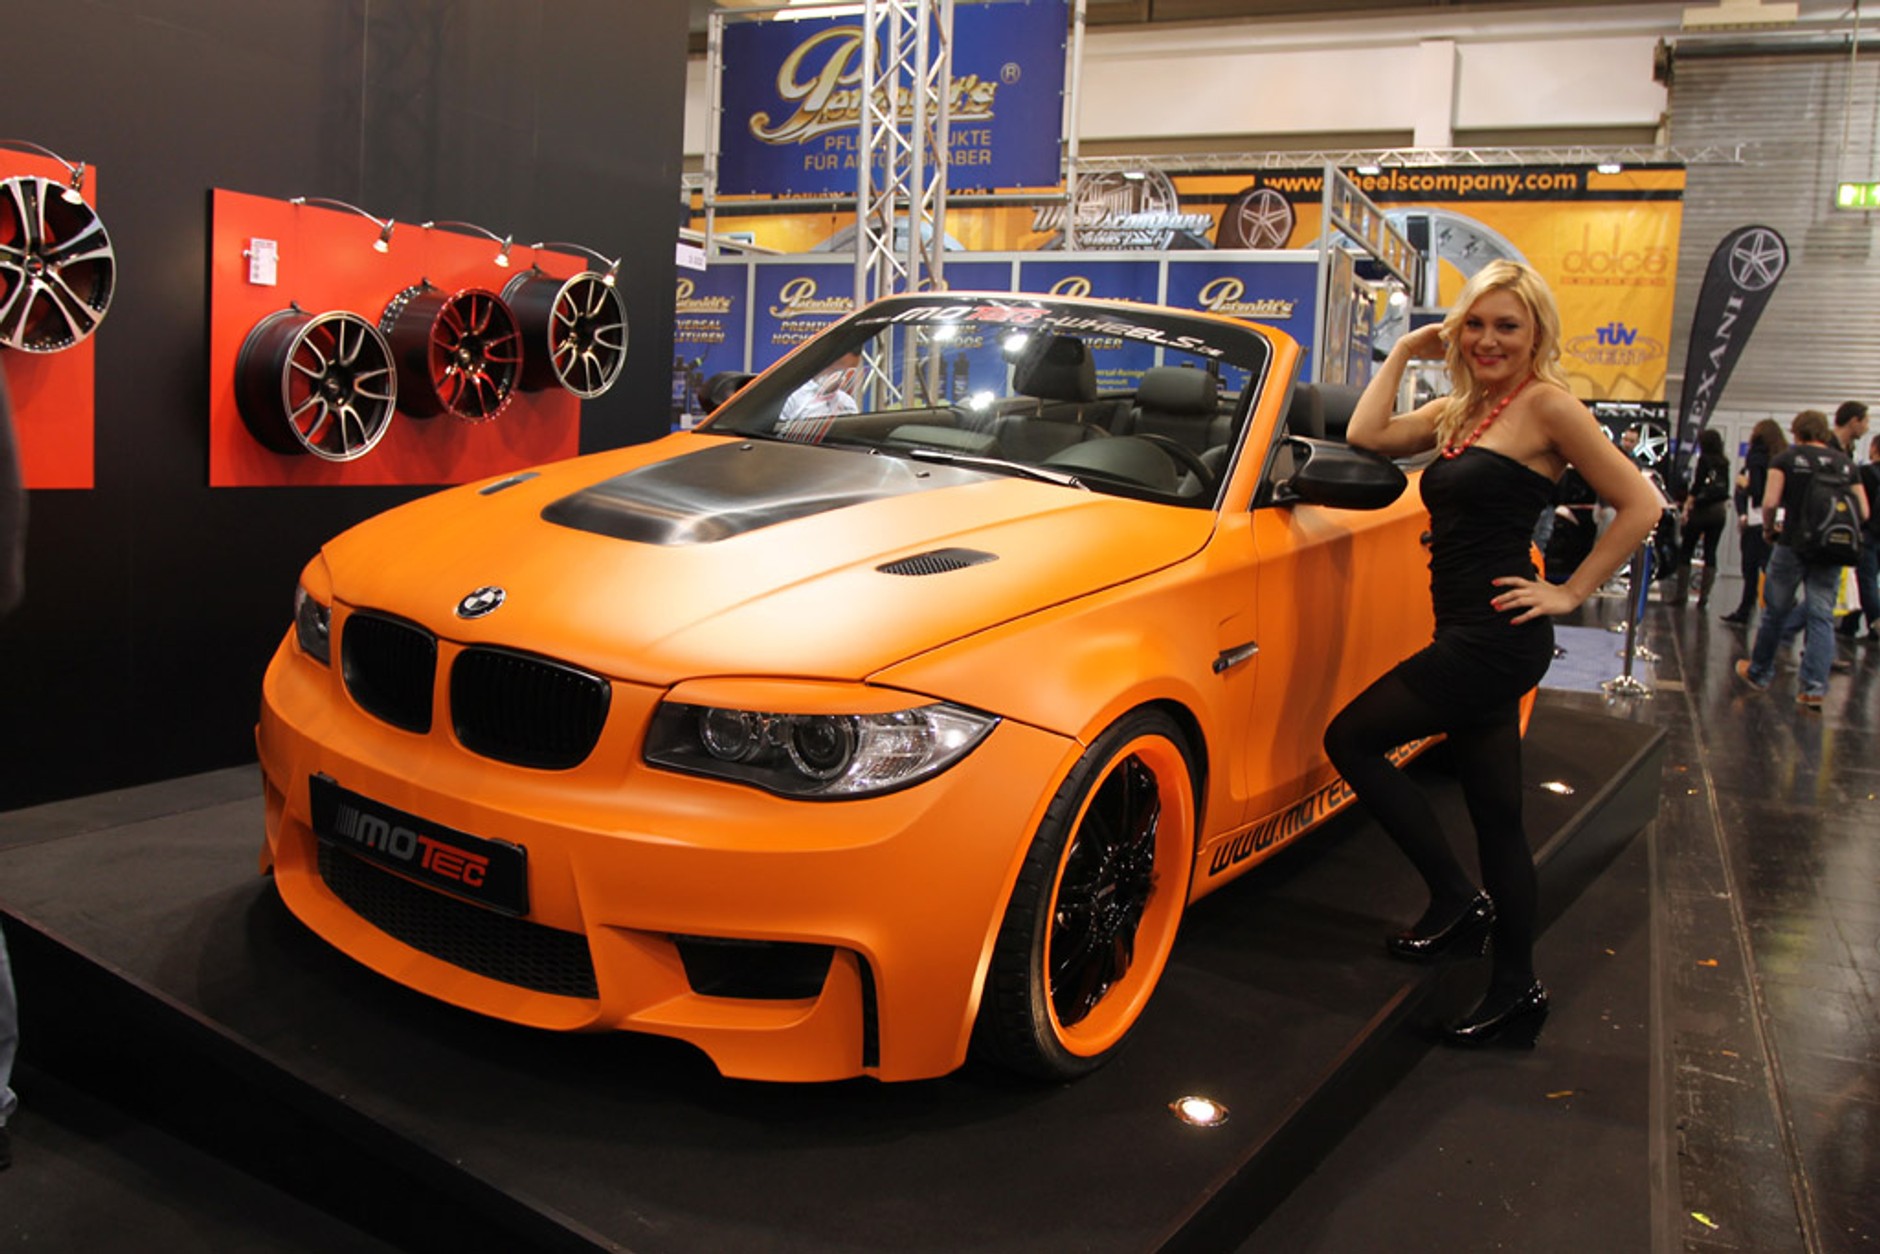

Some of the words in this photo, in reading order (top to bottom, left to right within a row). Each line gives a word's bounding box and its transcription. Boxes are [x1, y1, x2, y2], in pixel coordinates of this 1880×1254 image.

[804, 153, 838, 171] FÜR
[1263, 167, 1577, 195] www.heelscompany.com
[1596, 322, 1638, 345] TÜV
[354, 812, 490, 888] MOTEC
